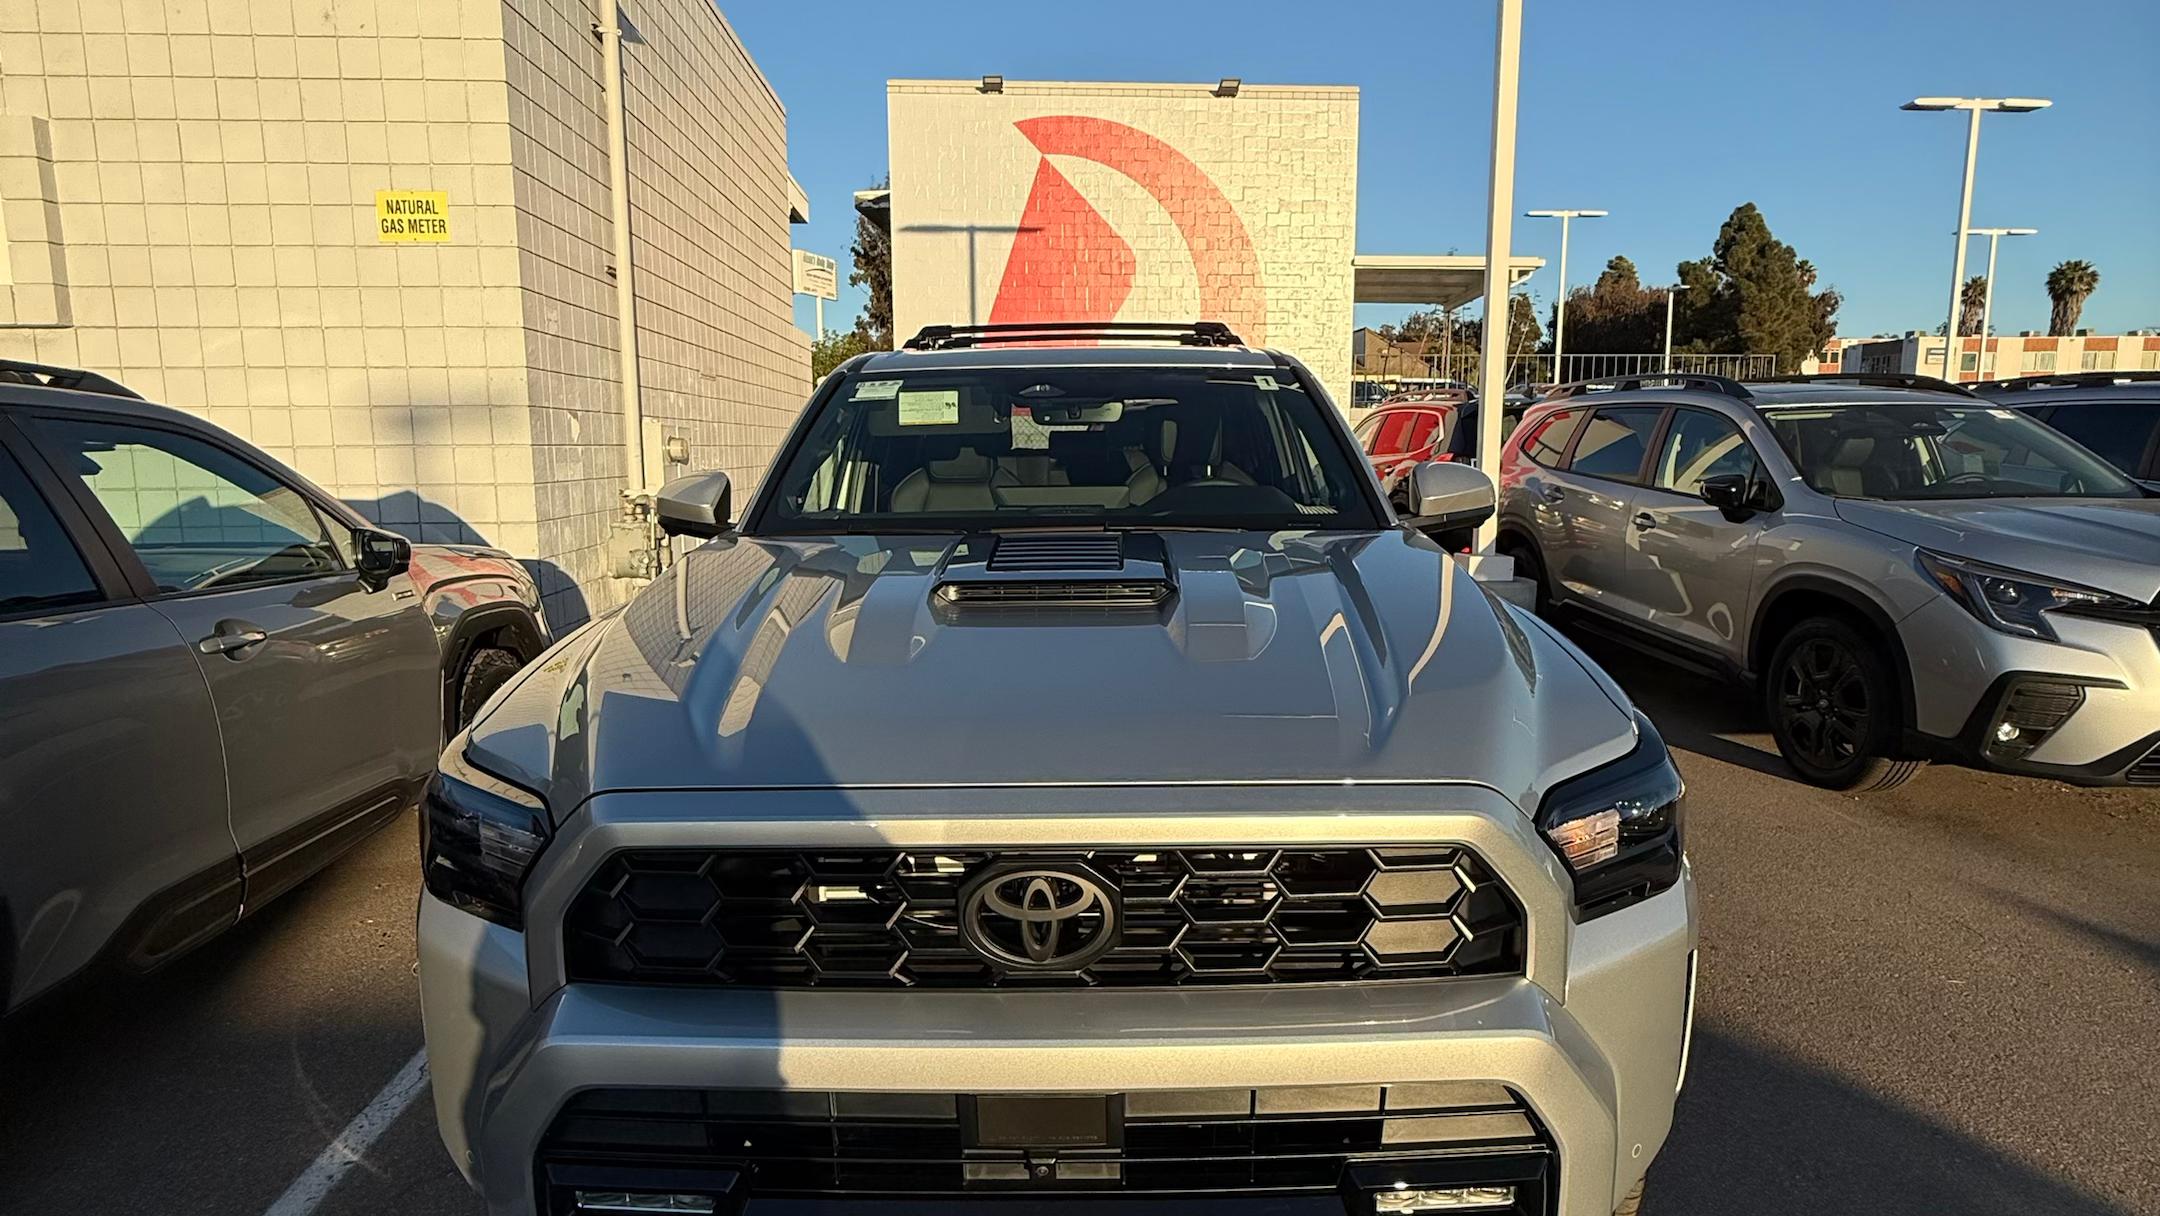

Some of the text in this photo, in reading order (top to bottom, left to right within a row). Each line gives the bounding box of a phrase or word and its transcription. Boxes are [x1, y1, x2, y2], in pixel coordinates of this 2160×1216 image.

[386, 199, 439, 215] NATURAL
[381, 218, 447, 234] GAS METER
